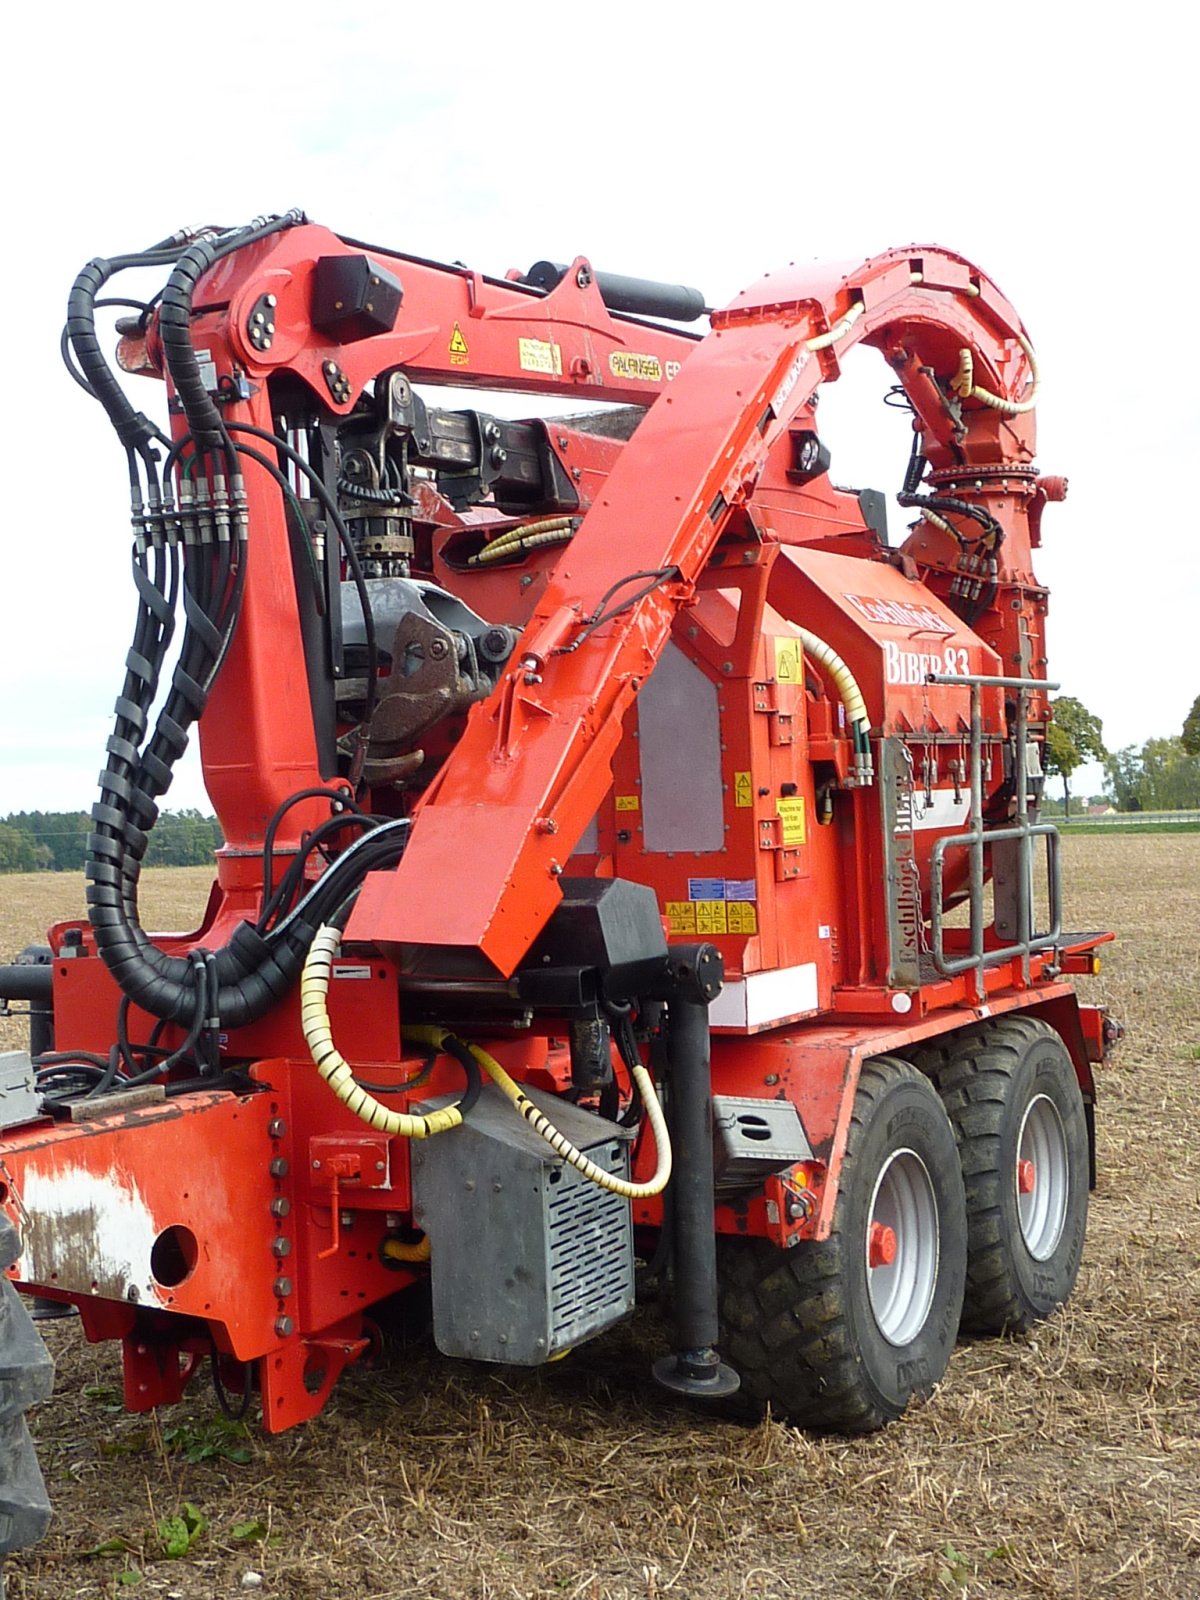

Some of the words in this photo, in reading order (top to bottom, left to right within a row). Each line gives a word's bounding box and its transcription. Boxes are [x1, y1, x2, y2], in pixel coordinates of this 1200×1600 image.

[612, 355, 660, 377] PALFINGER
[842, 593, 955, 633] Eschlböck
[944, 647, 970, 687] 83
[895, 849, 917, 964] Eschlböck
